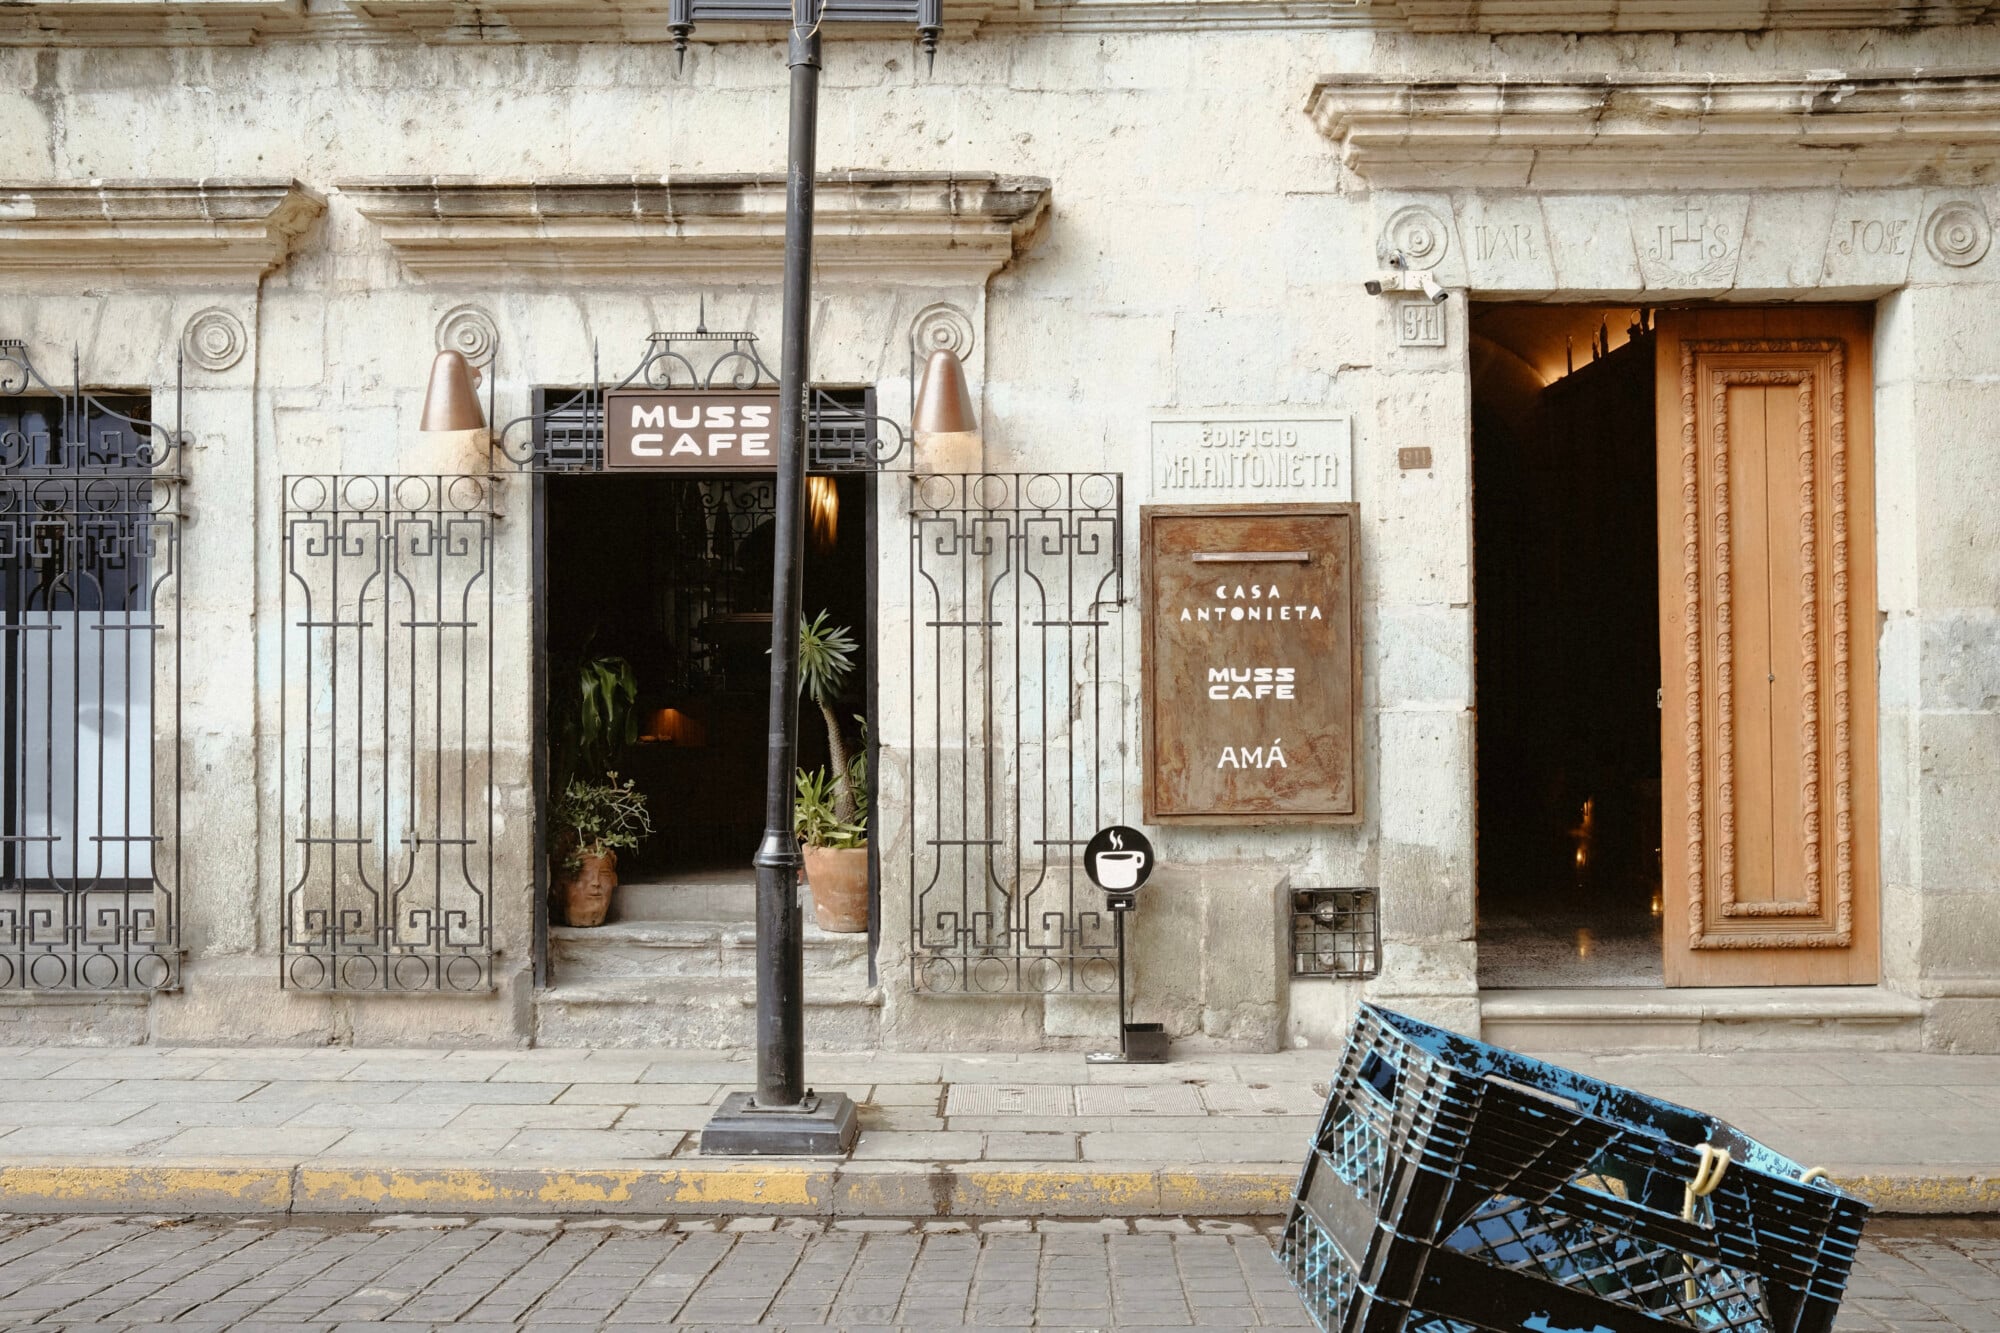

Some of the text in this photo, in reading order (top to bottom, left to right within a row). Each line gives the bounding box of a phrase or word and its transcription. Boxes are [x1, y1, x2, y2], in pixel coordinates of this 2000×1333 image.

[1403, 306, 1439, 341] 911
[631, 405, 772, 428] MUSS
[631, 433, 771, 457] CAFE
[1200, 426, 1298, 448] EDIFICIO
[1216, 584, 1280, 600] CASA
[1180, 605, 1322, 622] ANTONIETA
[1208, 667, 1296, 683] MUSS
[1208, 684, 1296, 700] CAFE
[1217, 738, 1288, 769] AMÁ
